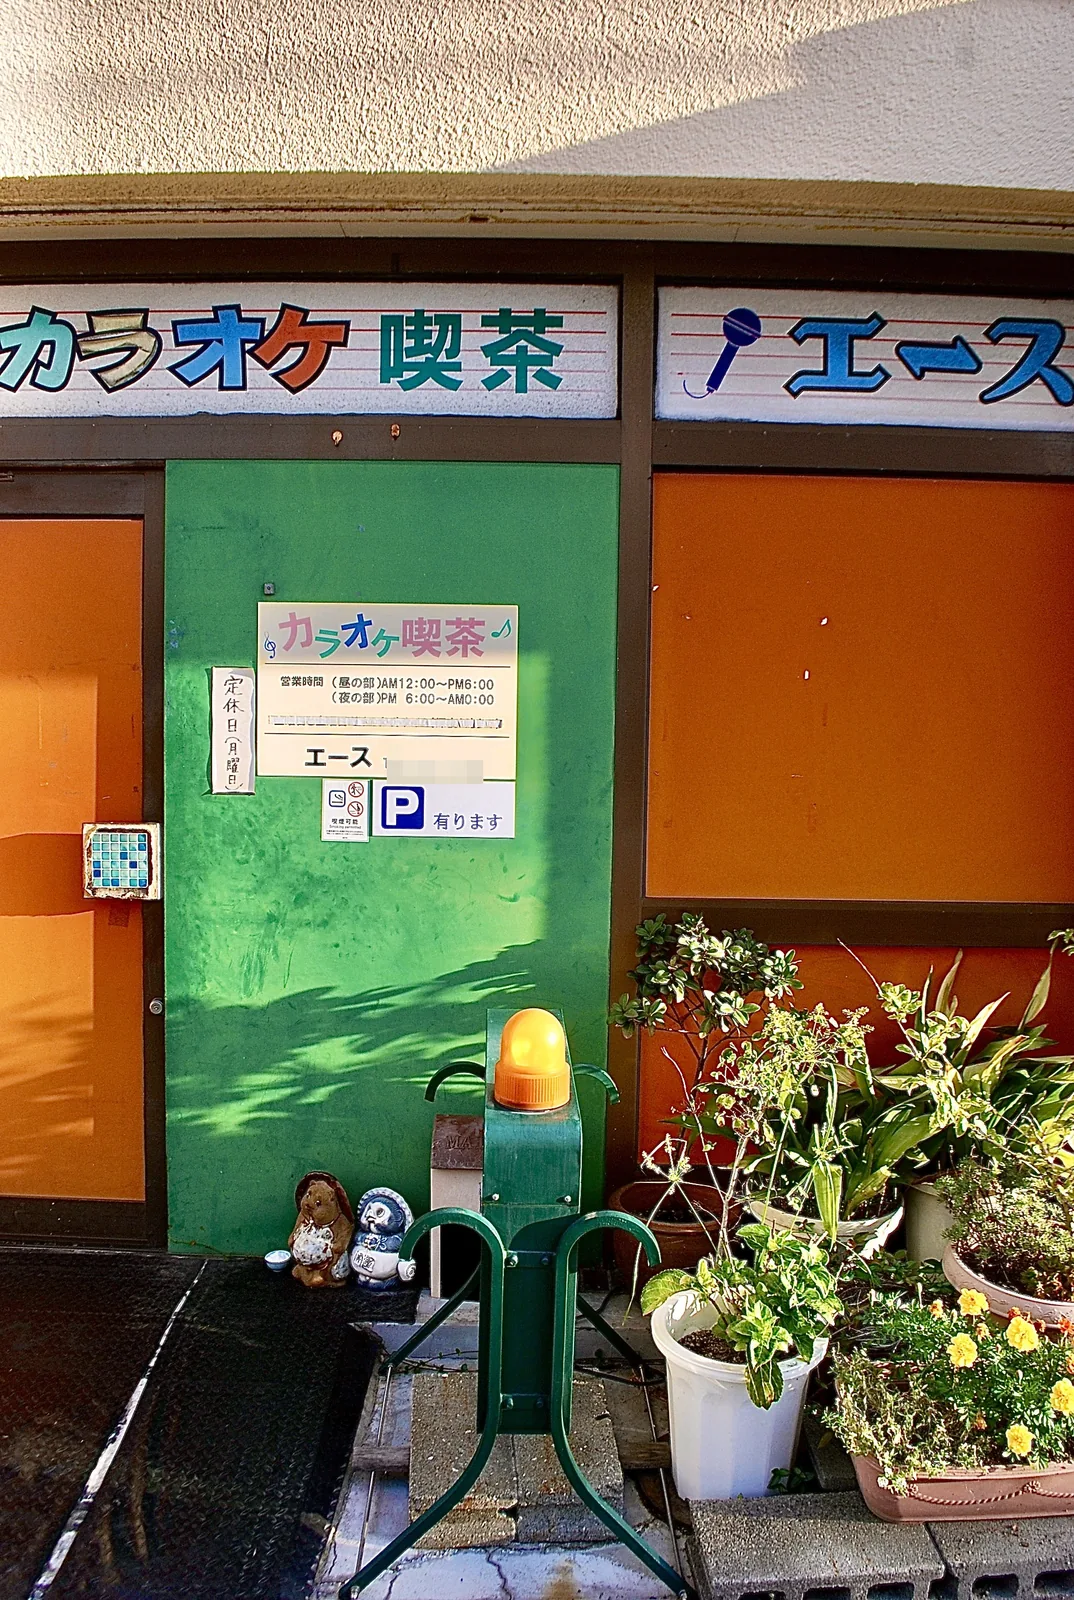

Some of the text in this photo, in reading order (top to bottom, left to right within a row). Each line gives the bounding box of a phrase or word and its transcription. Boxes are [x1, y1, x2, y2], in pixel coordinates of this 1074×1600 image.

[782, 310, 1074, 407] エース
[278, 611, 486, 659] カラオケ喫茶
[280, 675, 324, 688] 営業時間
[304, 746, 373, 768] エース
[385, 789, 420, 826] P
[433, 812, 503, 831] 有ります
